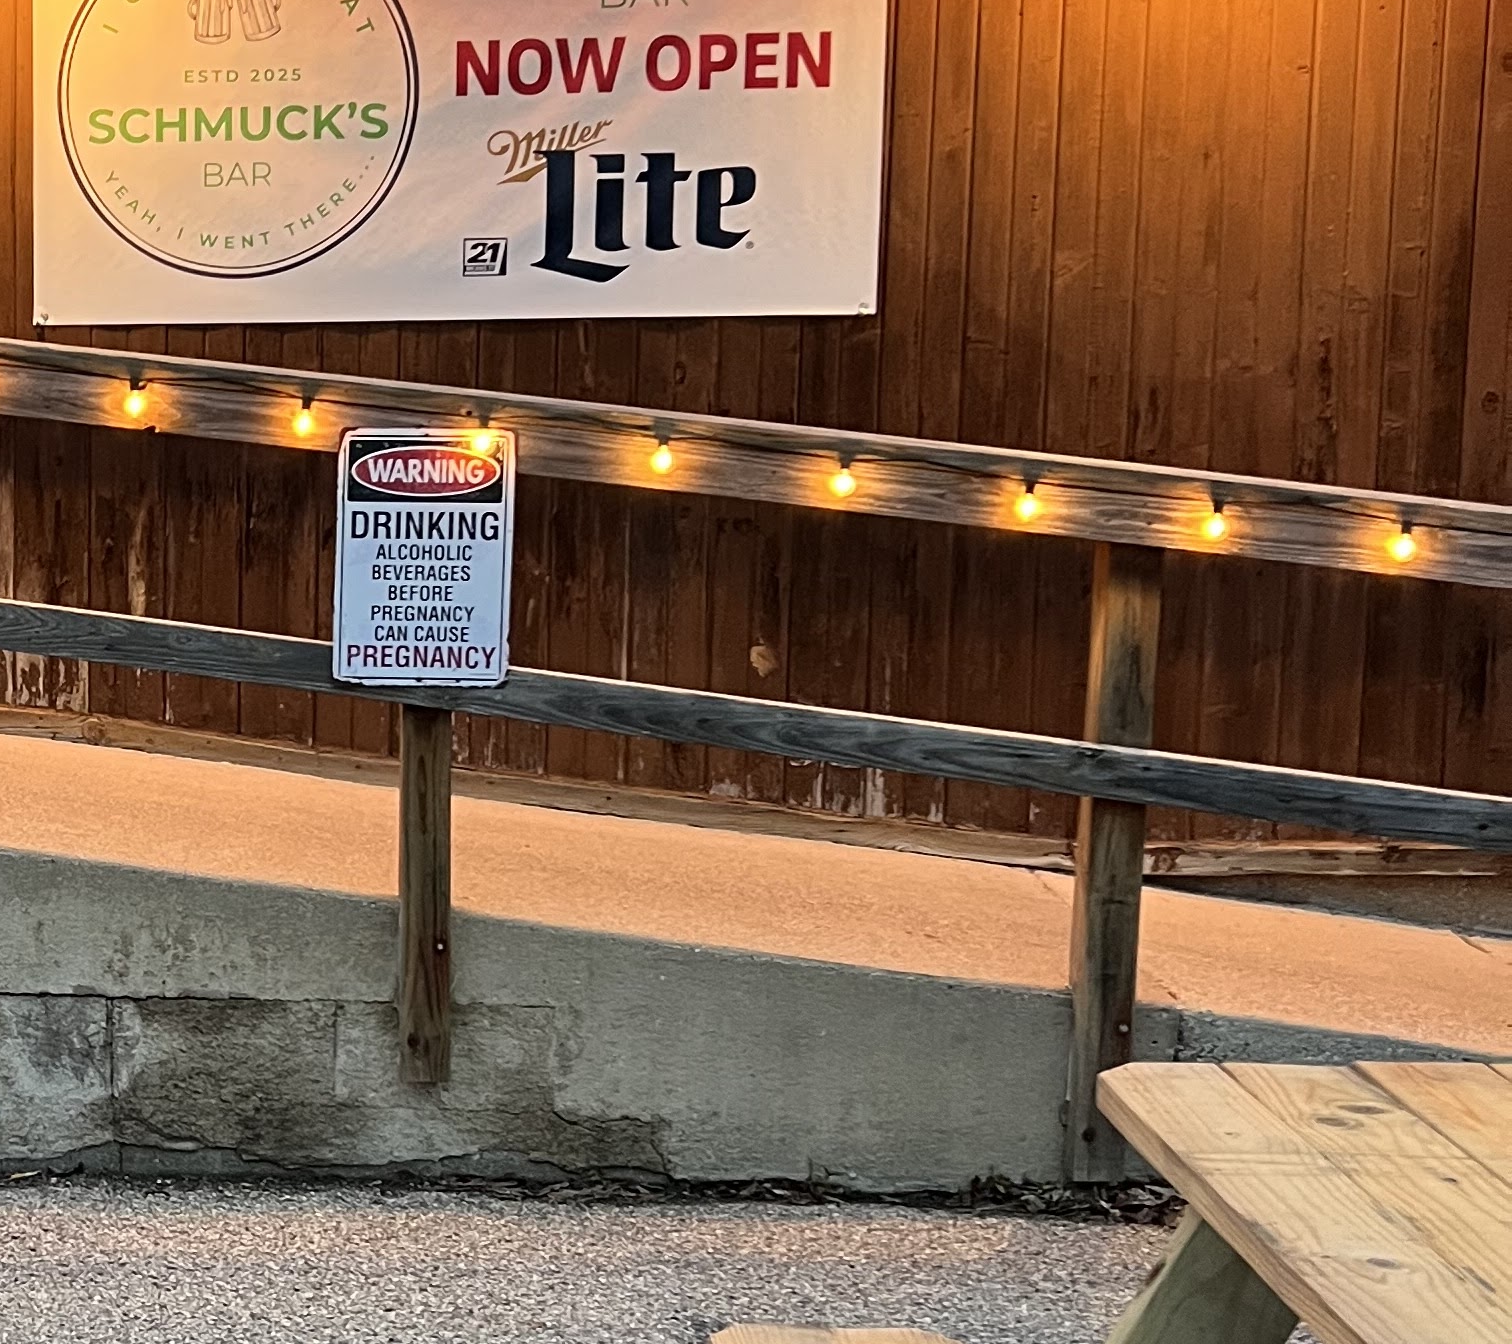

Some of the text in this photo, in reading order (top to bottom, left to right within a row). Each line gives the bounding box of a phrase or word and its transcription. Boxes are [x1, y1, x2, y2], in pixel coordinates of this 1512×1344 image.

[102, 23, 119, 34] I
[184, 68, 302, 84] ESTD 2025
[455, 31, 832, 97] NOW OPEN
[88, 102, 389, 144] SCHMUCK'S
[487, 119, 614, 176] Miller
[203, 162, 272, 187] BAR
[105, 170, 162, 233] YEAH,
[177, 227, 184, 240] I
[200, 231, 270, 250] WENT
[530, 152, 757, 283] Lite
[467, 242, 501, 263] 21
[367, 458, 486, 484] WARNING
[350, 511, 499, 541] DRINKING
[375, 543, 473, 562] ALCOHOLIC
[372, 565, 471, 582] BEVERAGES
[388, 585, 454, 602] BEFORE
[370, 605, 475, 623] PREGNANCY
[374, 625, 470, 643] CAN CAUSE
[346, 645, 497, 669] PREGNANCY
